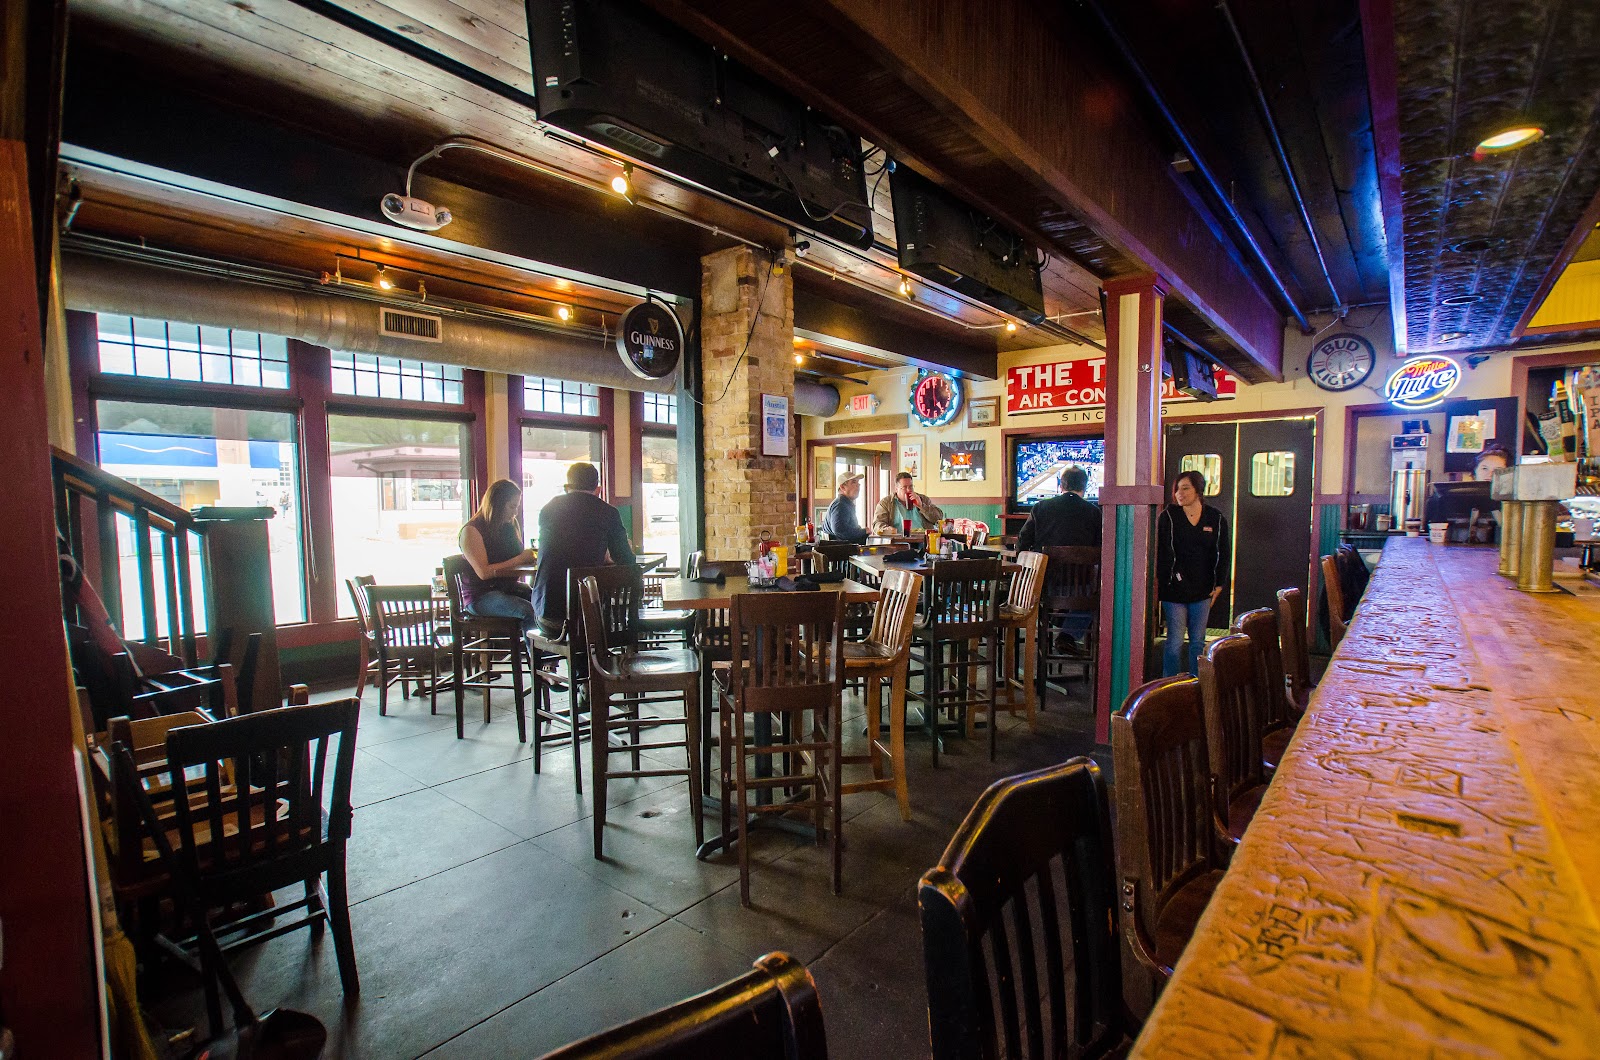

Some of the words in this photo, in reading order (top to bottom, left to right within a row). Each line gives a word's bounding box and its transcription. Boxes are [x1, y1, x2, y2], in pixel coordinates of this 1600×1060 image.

[630, 331, 675, 351] GUINNESS
[1320, 338, 1360, 356] BUD
[1016, 362, 1073, 390] THE
[1087, 358, 1107, 383] T
[1405, 361, 1450, 377] Miller
[853, 395, 869, 411] EXIT
[1019, 392, 1054, 410] AIR
[1065, 387, 1107, 405] CON
[1061, 411, 1104, 422] SINC
